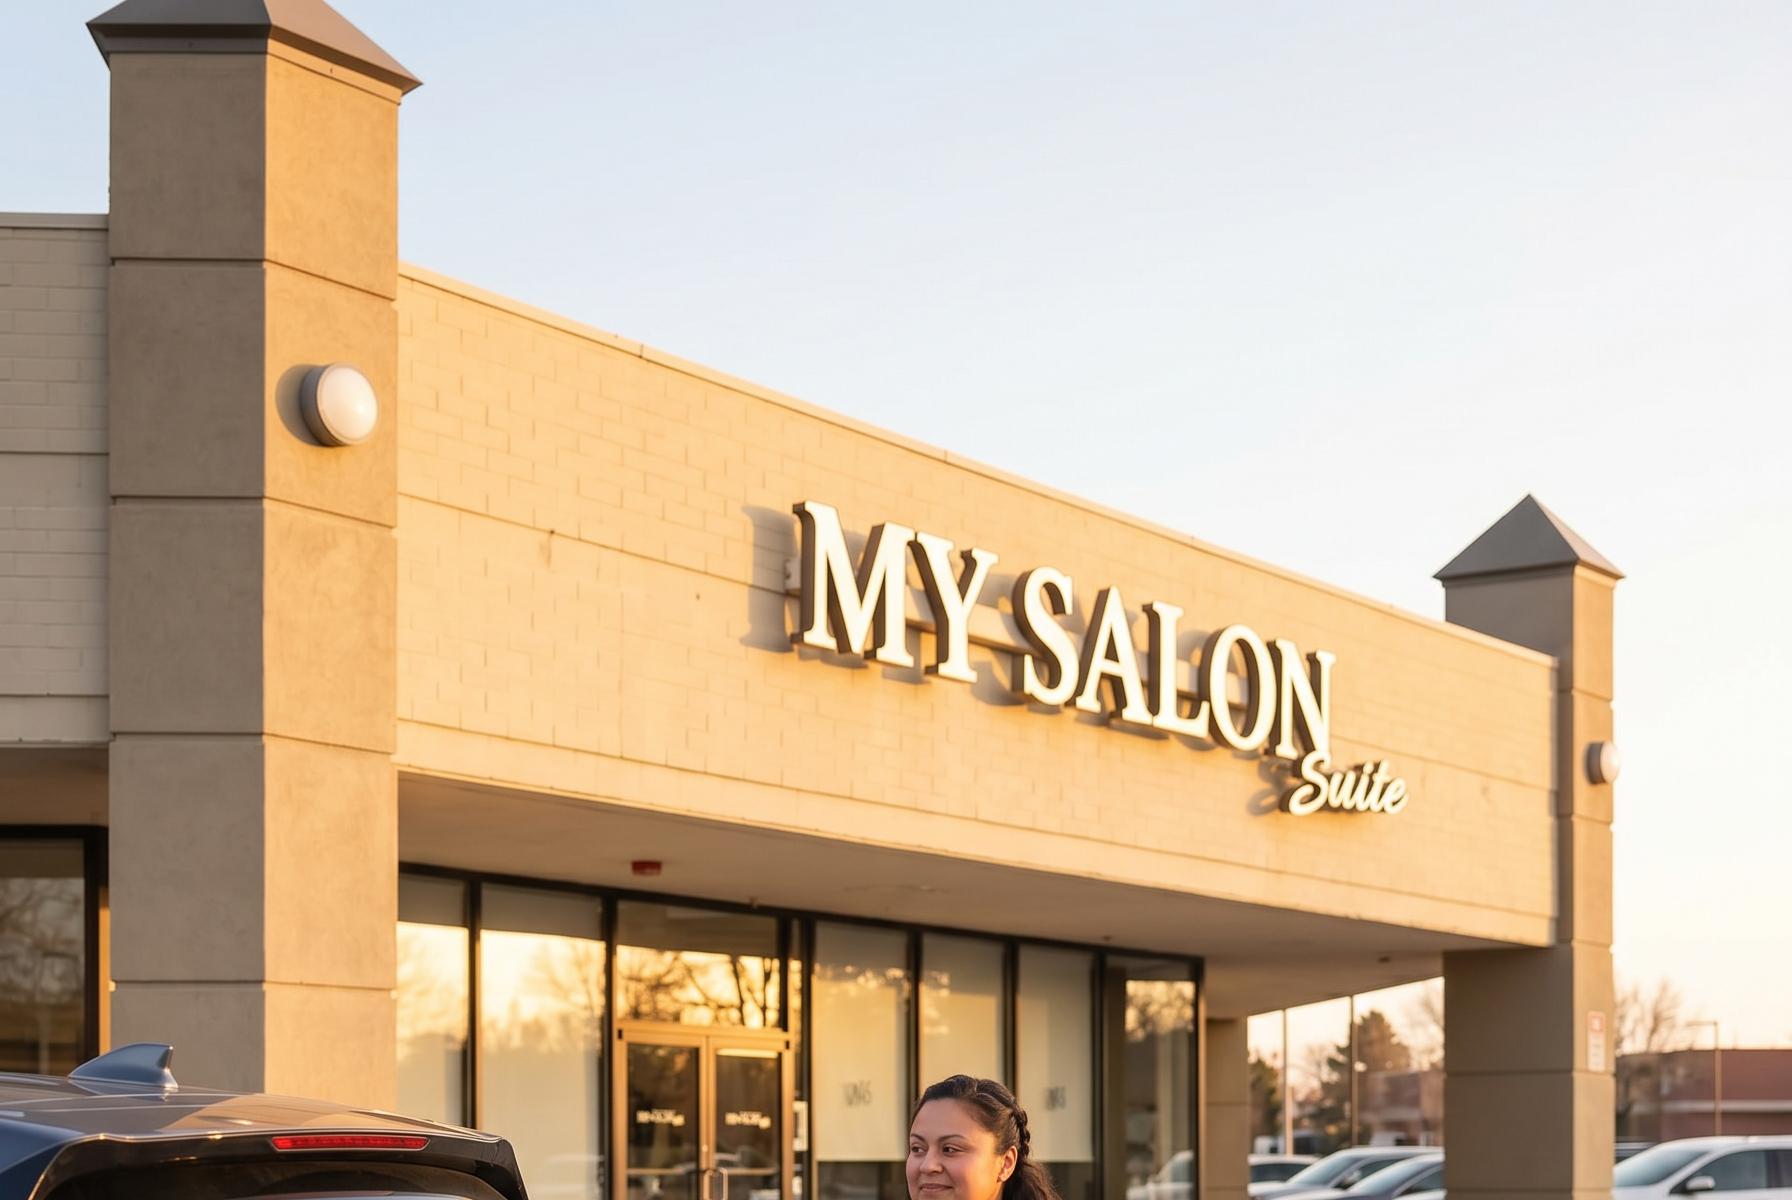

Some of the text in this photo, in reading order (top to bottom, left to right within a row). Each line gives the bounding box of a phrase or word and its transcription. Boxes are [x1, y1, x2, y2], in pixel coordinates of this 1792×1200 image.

[795, 500, 1337, 760] MY SALON
[1284, 750, 1409, 817] Suite
